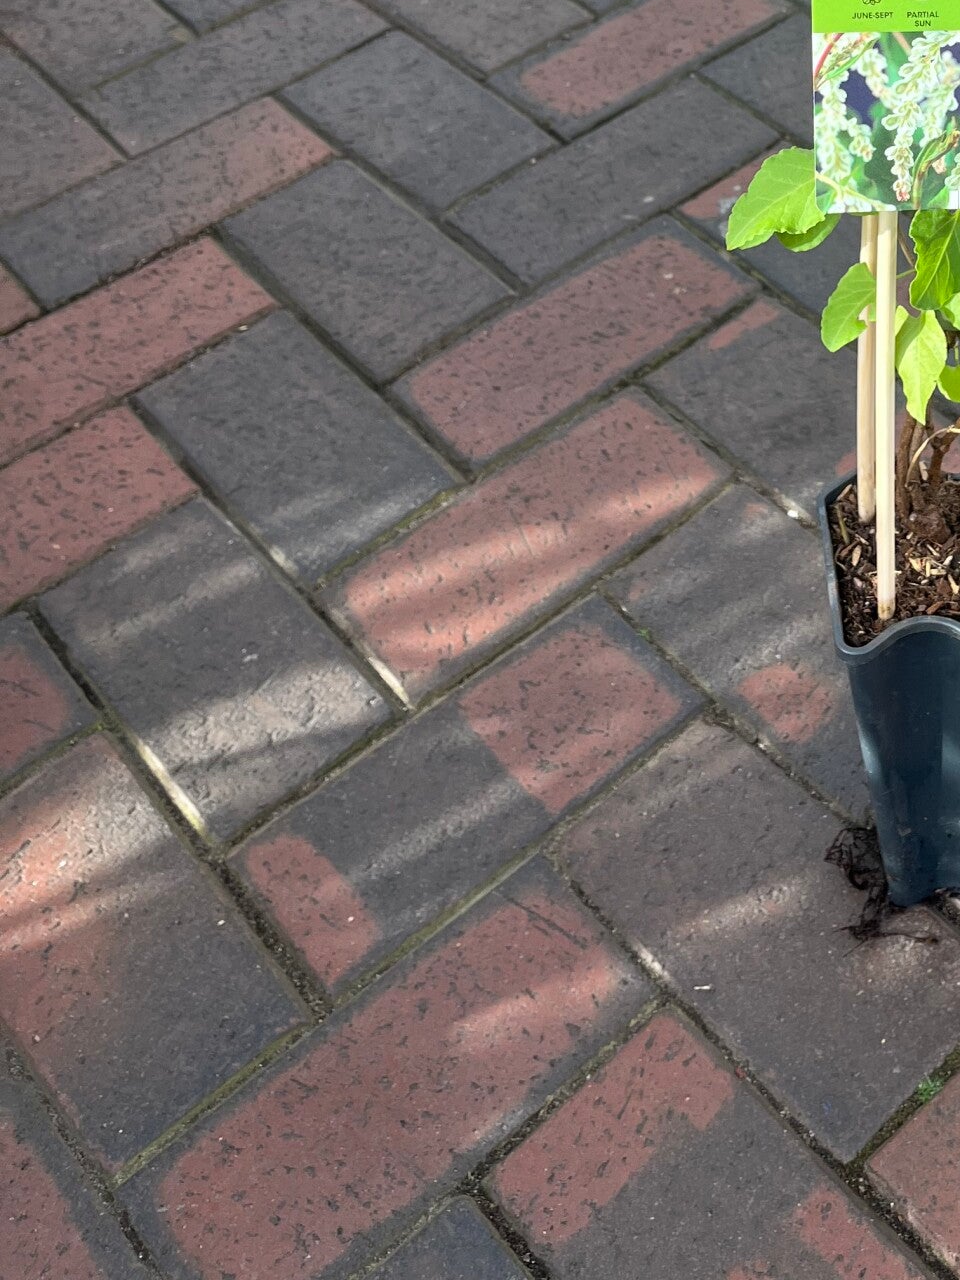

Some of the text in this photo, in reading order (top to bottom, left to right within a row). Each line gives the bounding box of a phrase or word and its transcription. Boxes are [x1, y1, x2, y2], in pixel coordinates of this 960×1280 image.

[851, 11, 894, 20] JUNE-SEPT
[906, 10, 940, 19] PARTIAL
[914, 19, 932, 28] SUN
